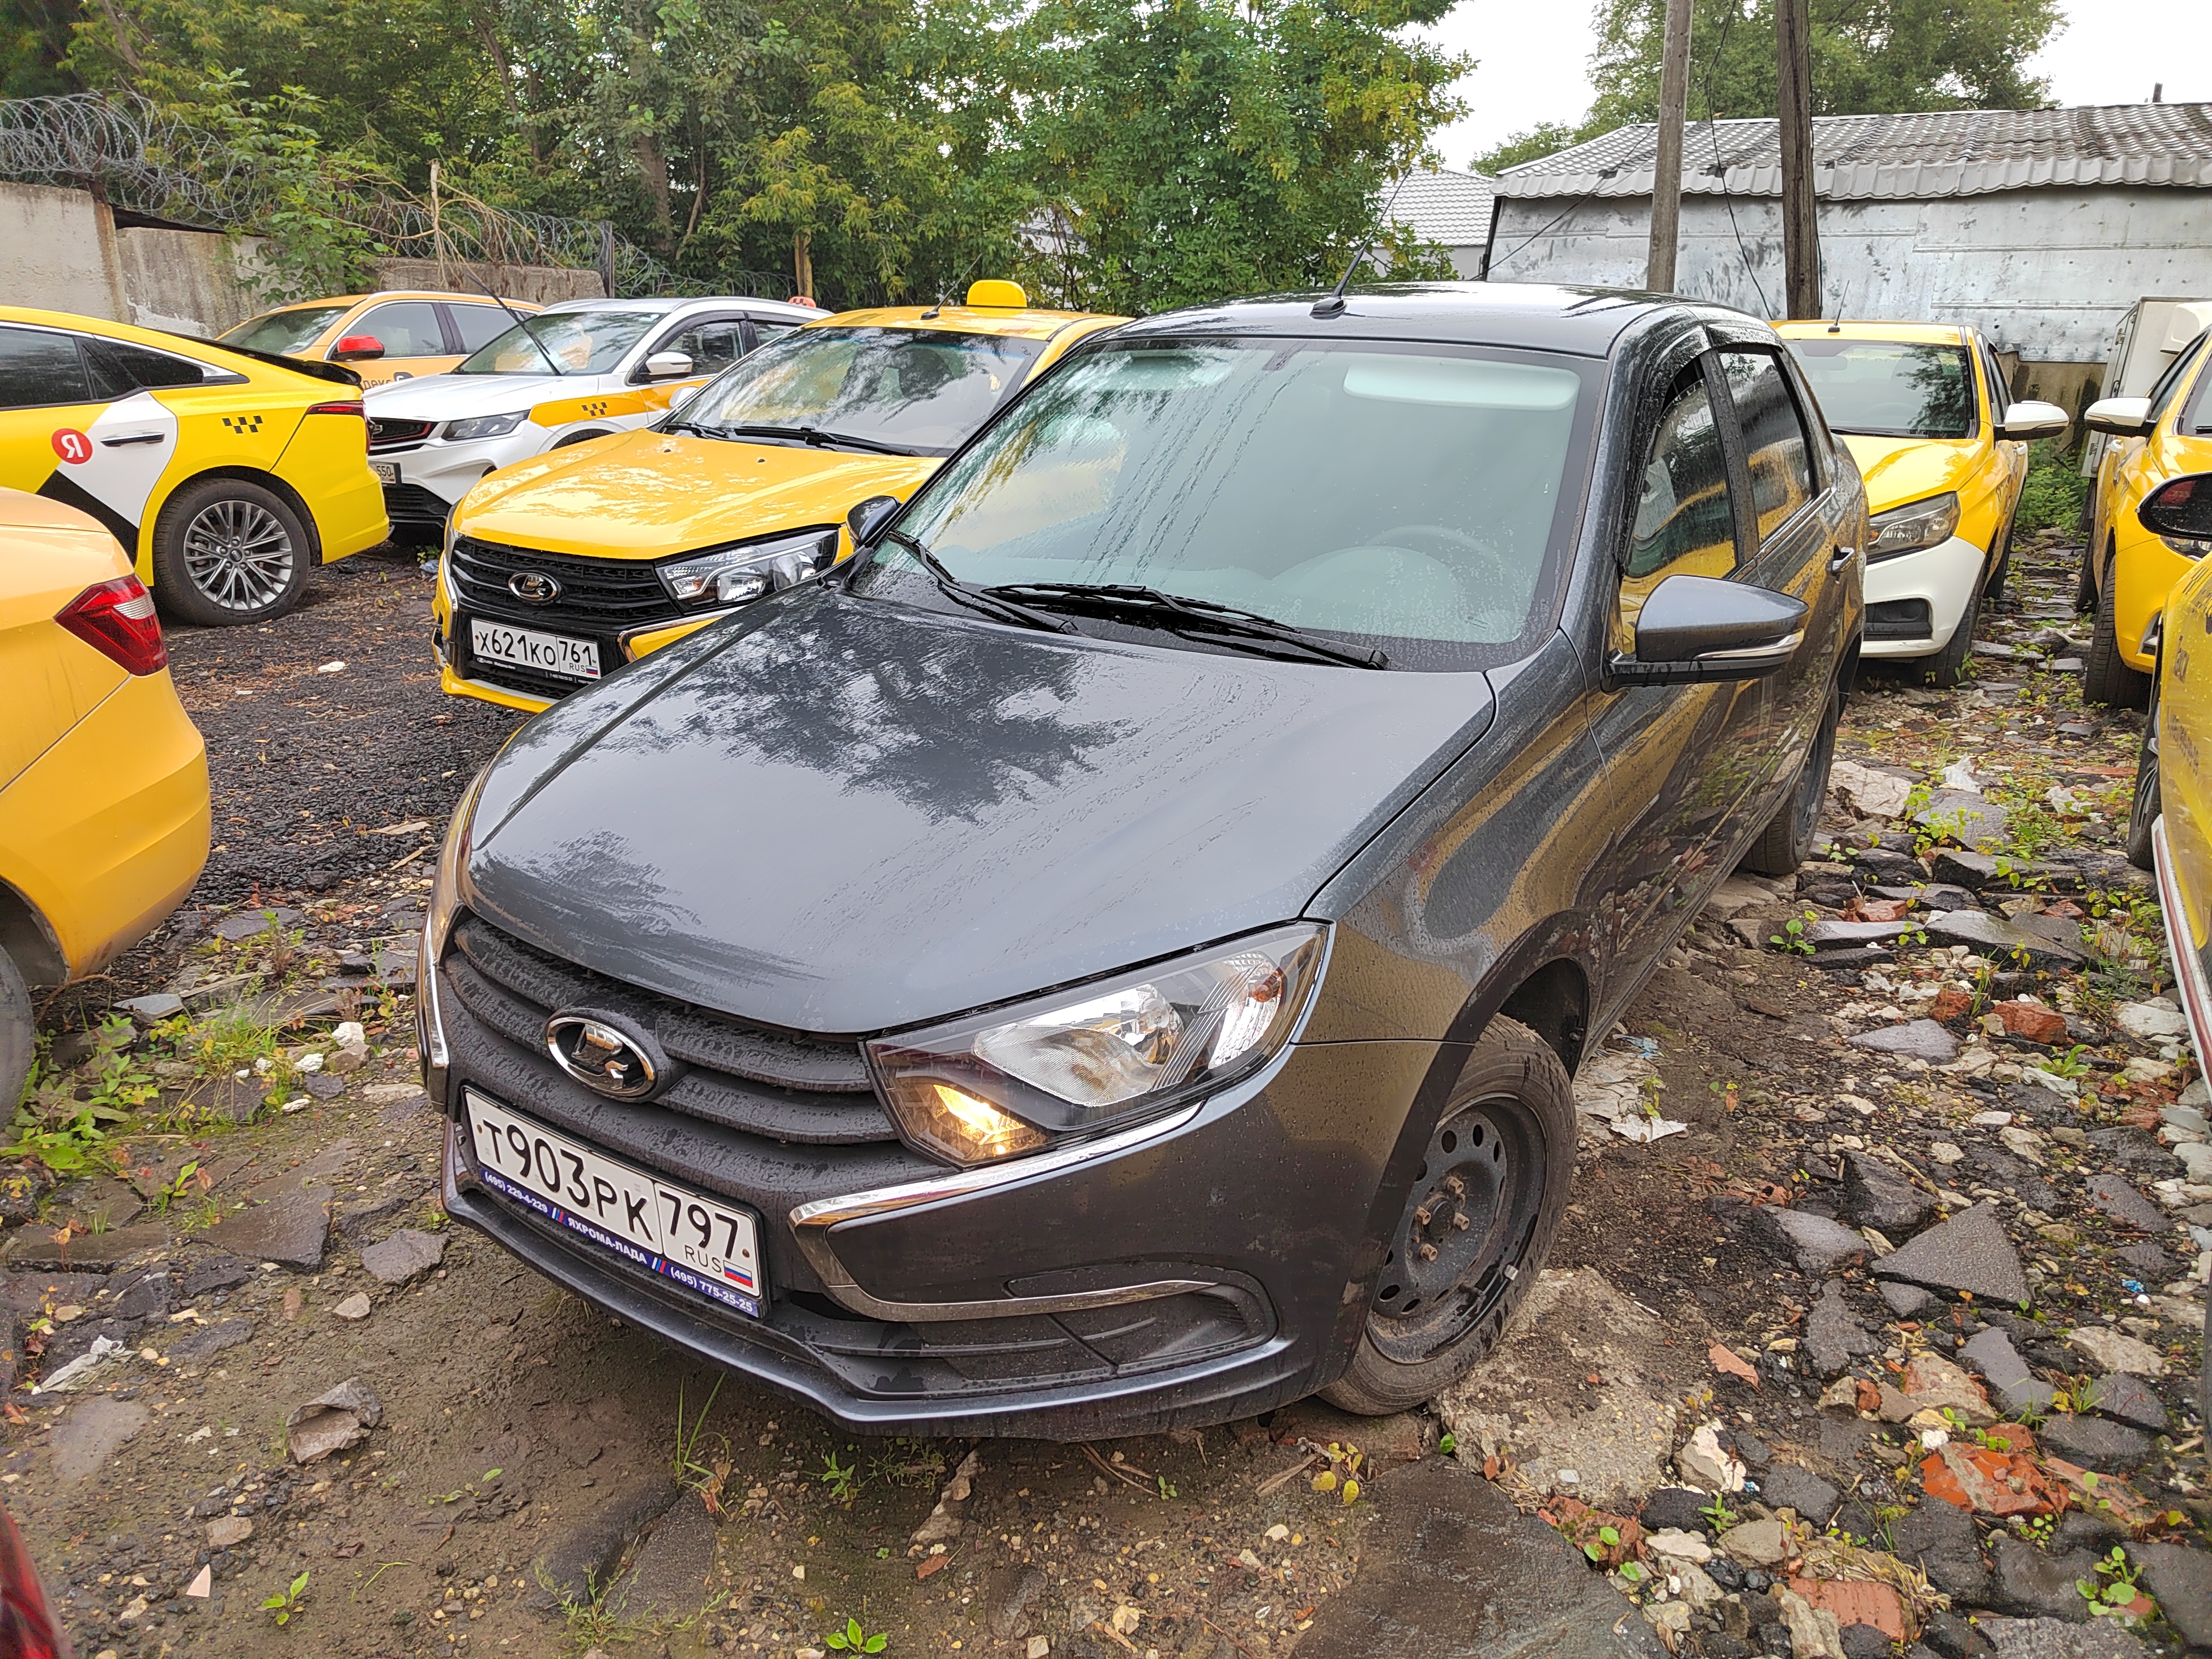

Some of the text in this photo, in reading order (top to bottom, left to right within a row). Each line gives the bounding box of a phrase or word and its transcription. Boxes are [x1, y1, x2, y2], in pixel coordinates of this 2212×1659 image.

[61, 434, 84, 458] Я
[478, 629, 592, 666] Х621КО 761
[569, 663, 585, 673] RUS
[483, 1118, 738, 1259] Т903РК 797
[485, 1171, 753, 1312] (495) 229-4-229 ЯХРОМА-ЛАДА (495) 775-25-25
[684, 1244, 722, 1273] RUS
